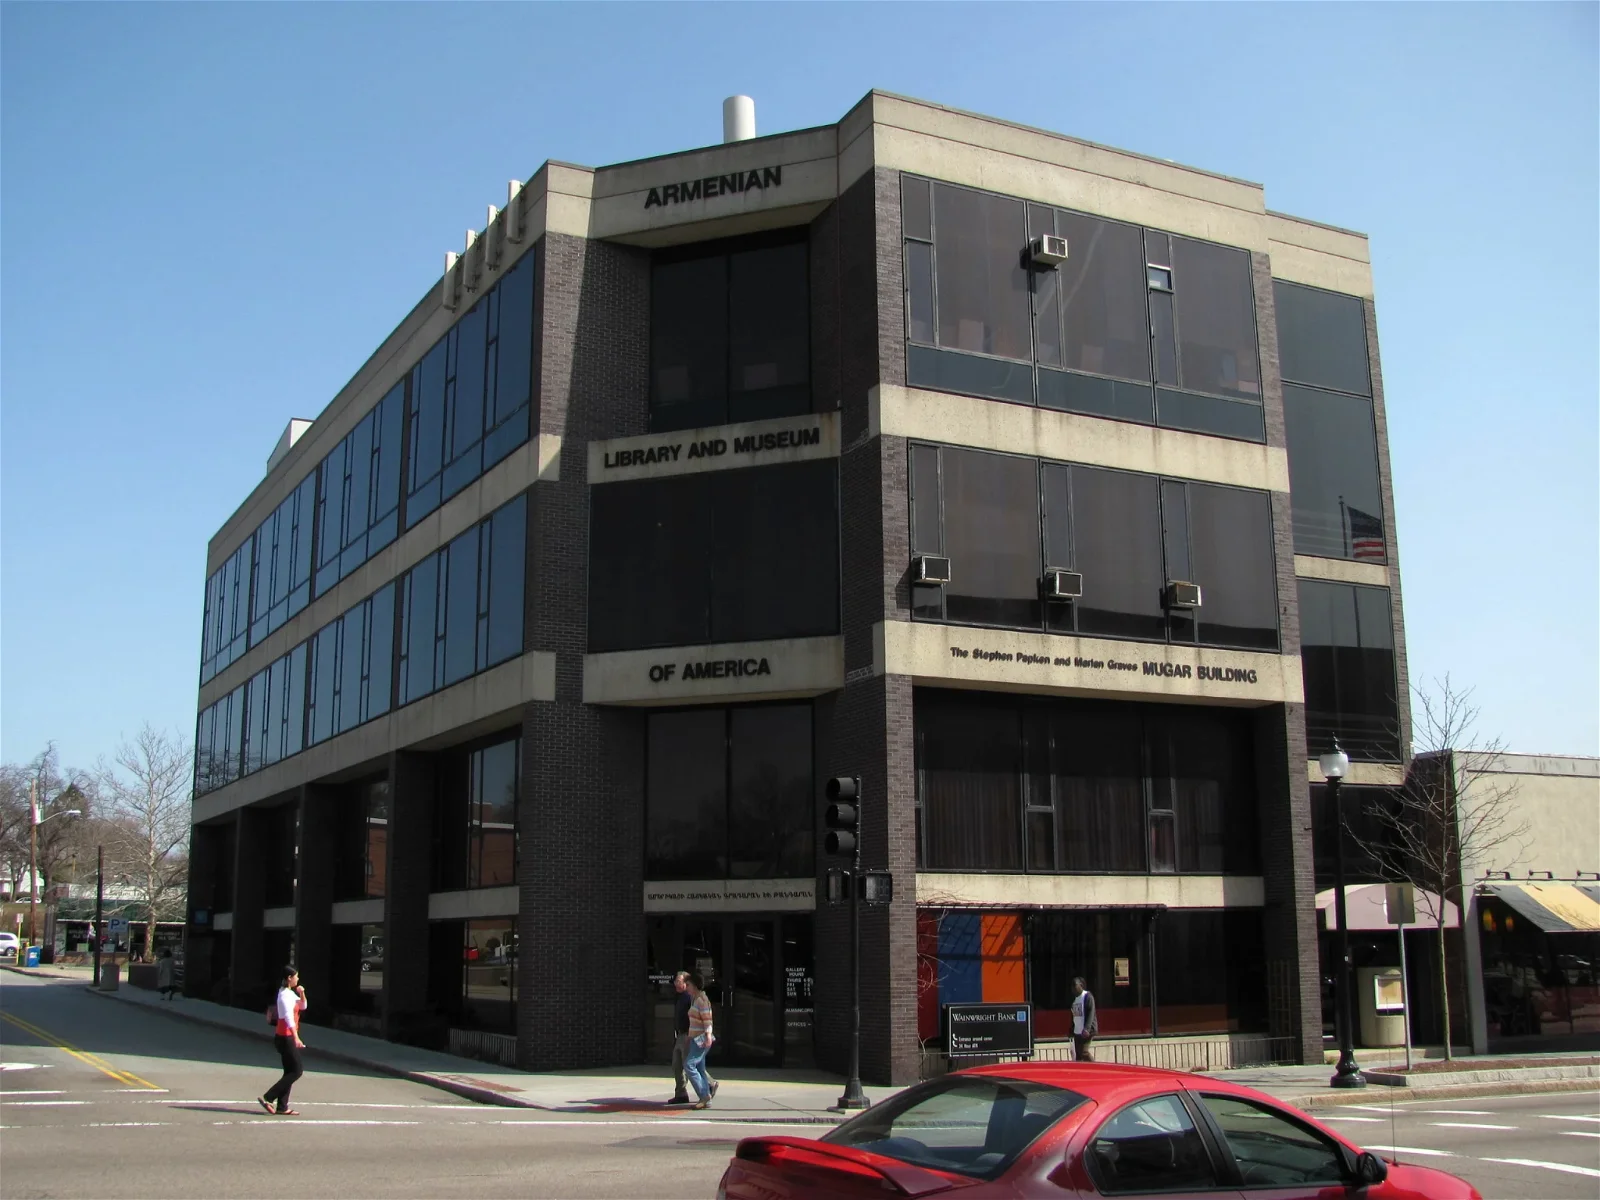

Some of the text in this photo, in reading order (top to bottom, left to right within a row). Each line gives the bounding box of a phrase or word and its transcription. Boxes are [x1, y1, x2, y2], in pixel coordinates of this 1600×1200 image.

[644, 166, 782, 209] ARMENIAN
[604, 428, 819, 468] LIBRARY AND MUSEUM
[649, 658, 771, 682] OF AMERICA
[950, 647, 1257, 684] The Stephen Papken and Marian Graves MUGAR BUILDING
[110, 919, 120, 929] P
[952, 1013, 1016, 1022] WAINWRIGHT BANK
